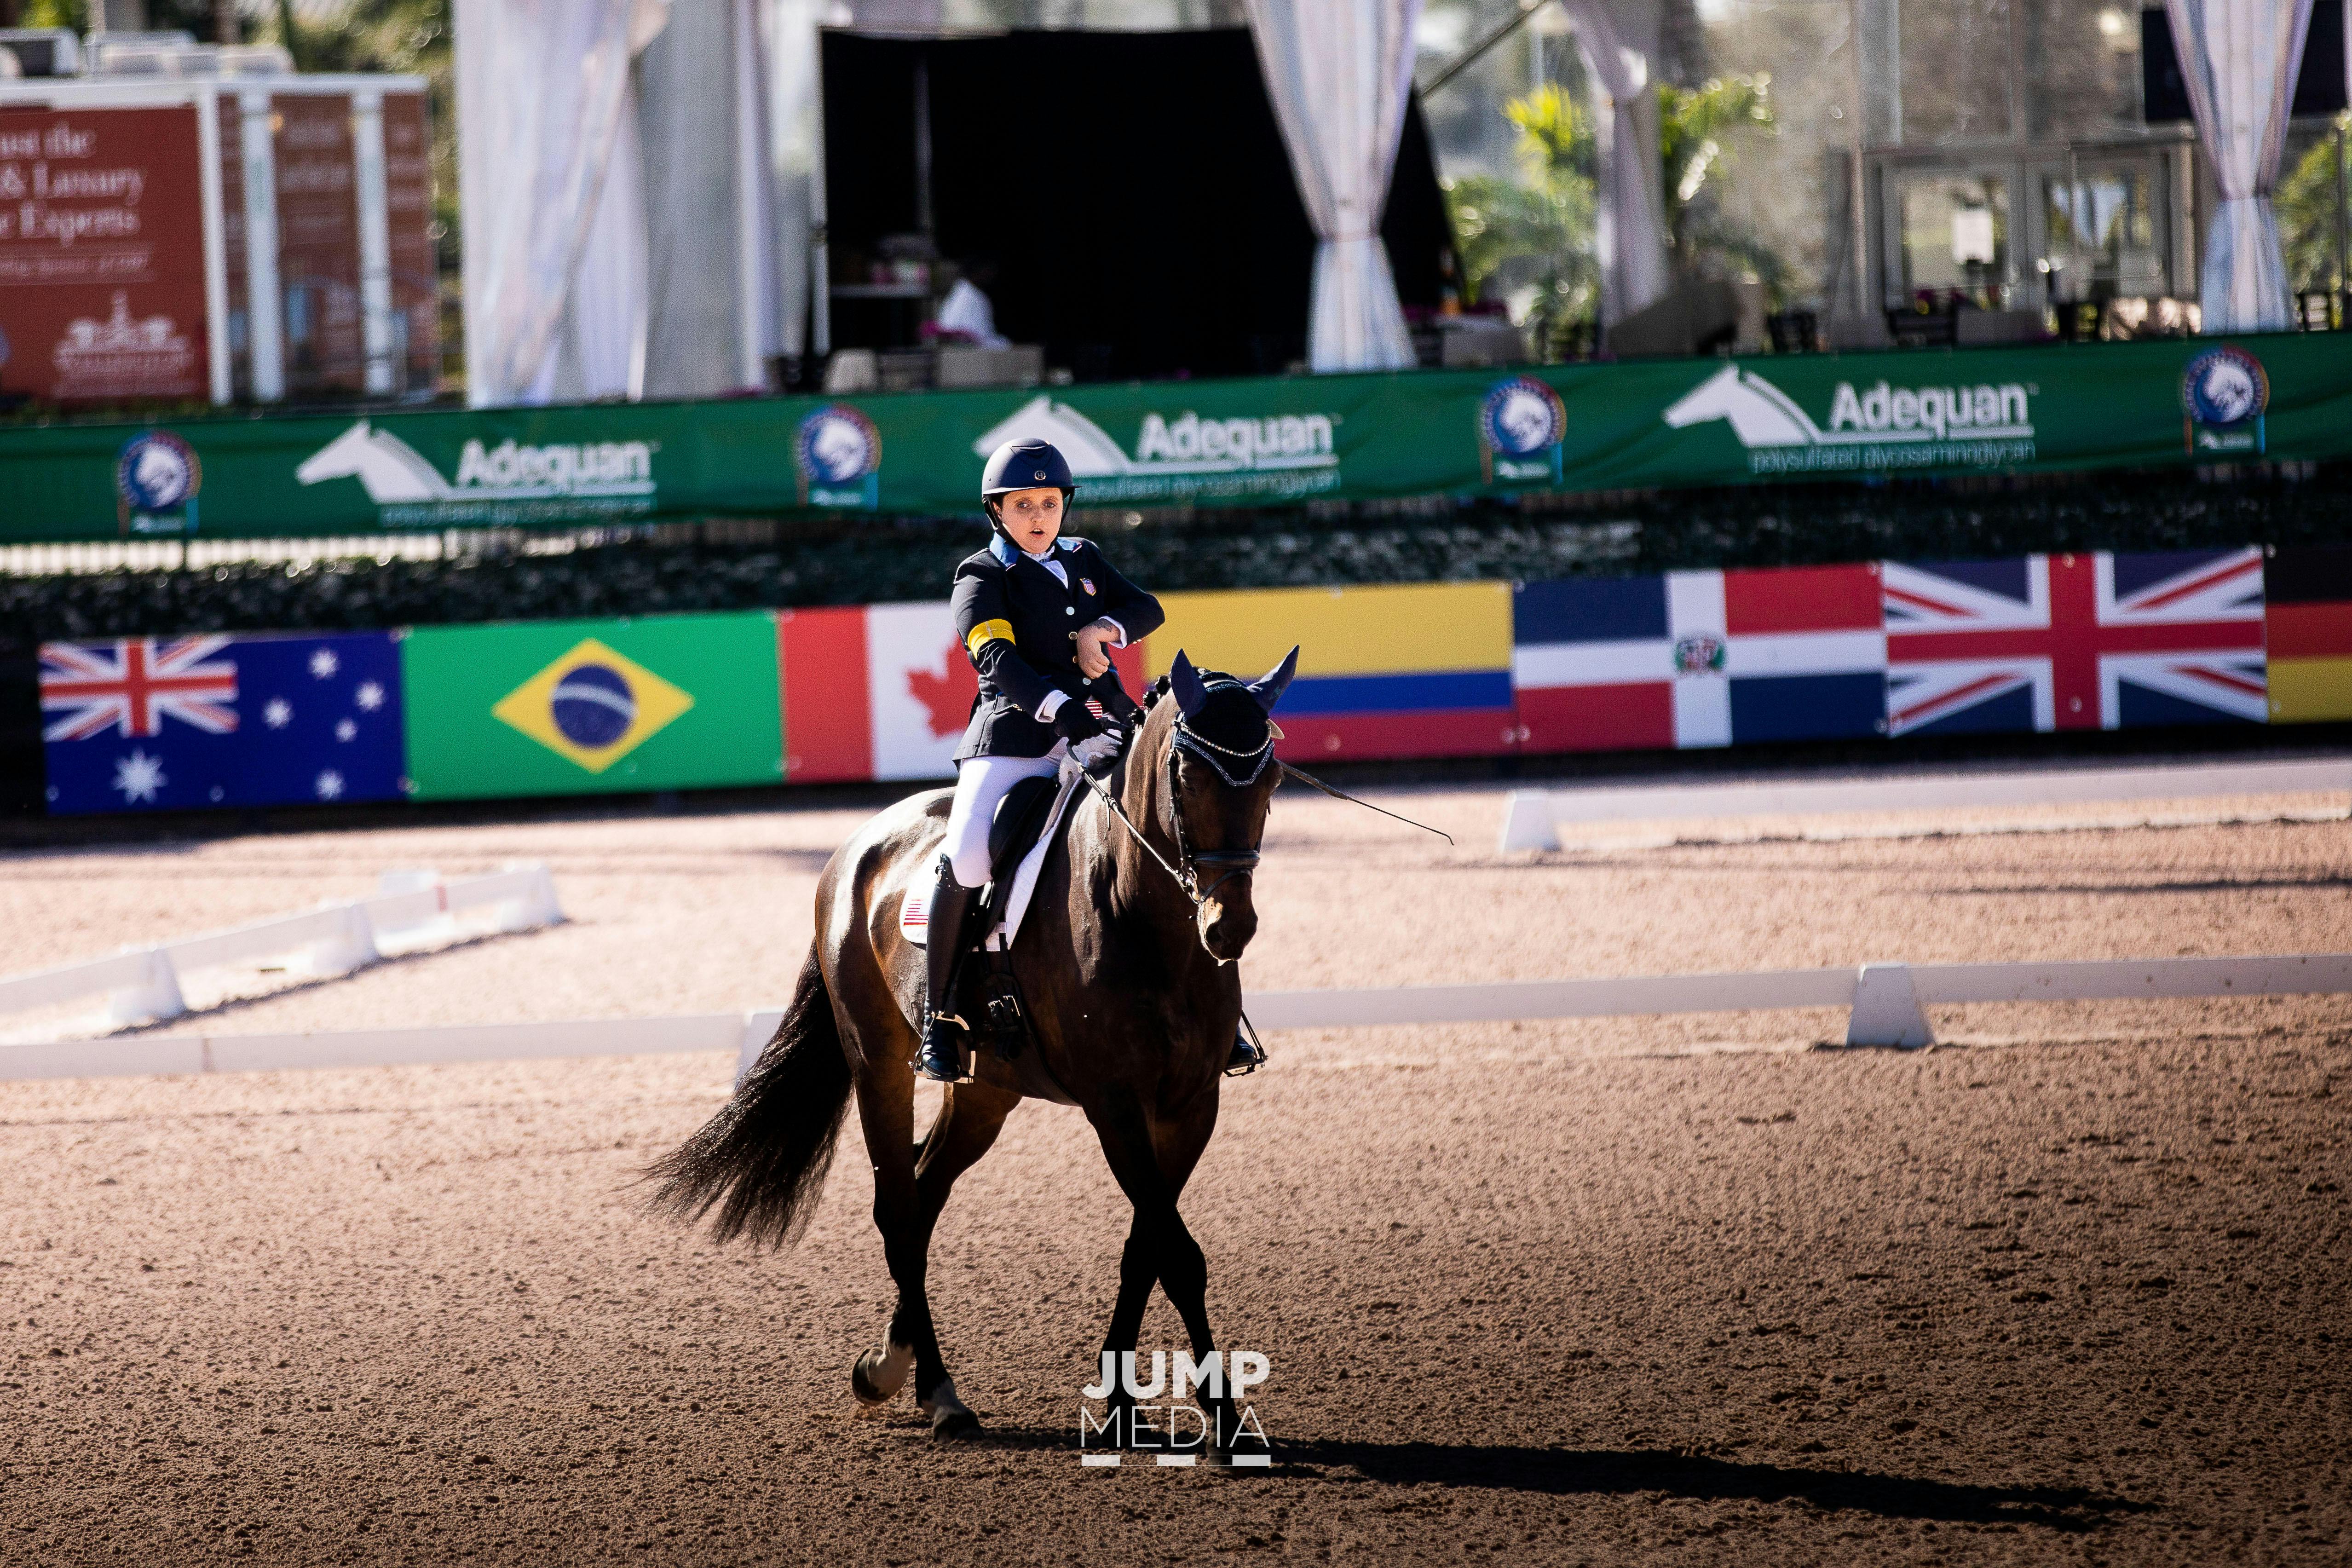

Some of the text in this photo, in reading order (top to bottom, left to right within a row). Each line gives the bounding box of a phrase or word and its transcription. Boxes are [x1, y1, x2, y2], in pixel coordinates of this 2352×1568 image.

[45, 120, 95, 157] the
[34, 161, 145, 206] Luxury
[20, 201, 140, 247] Experts
[1829, 379, 2028, 440] Adequan
[1136, 410, 1333, 468] Adequan
[457, 438, 652, 494] Adequan
